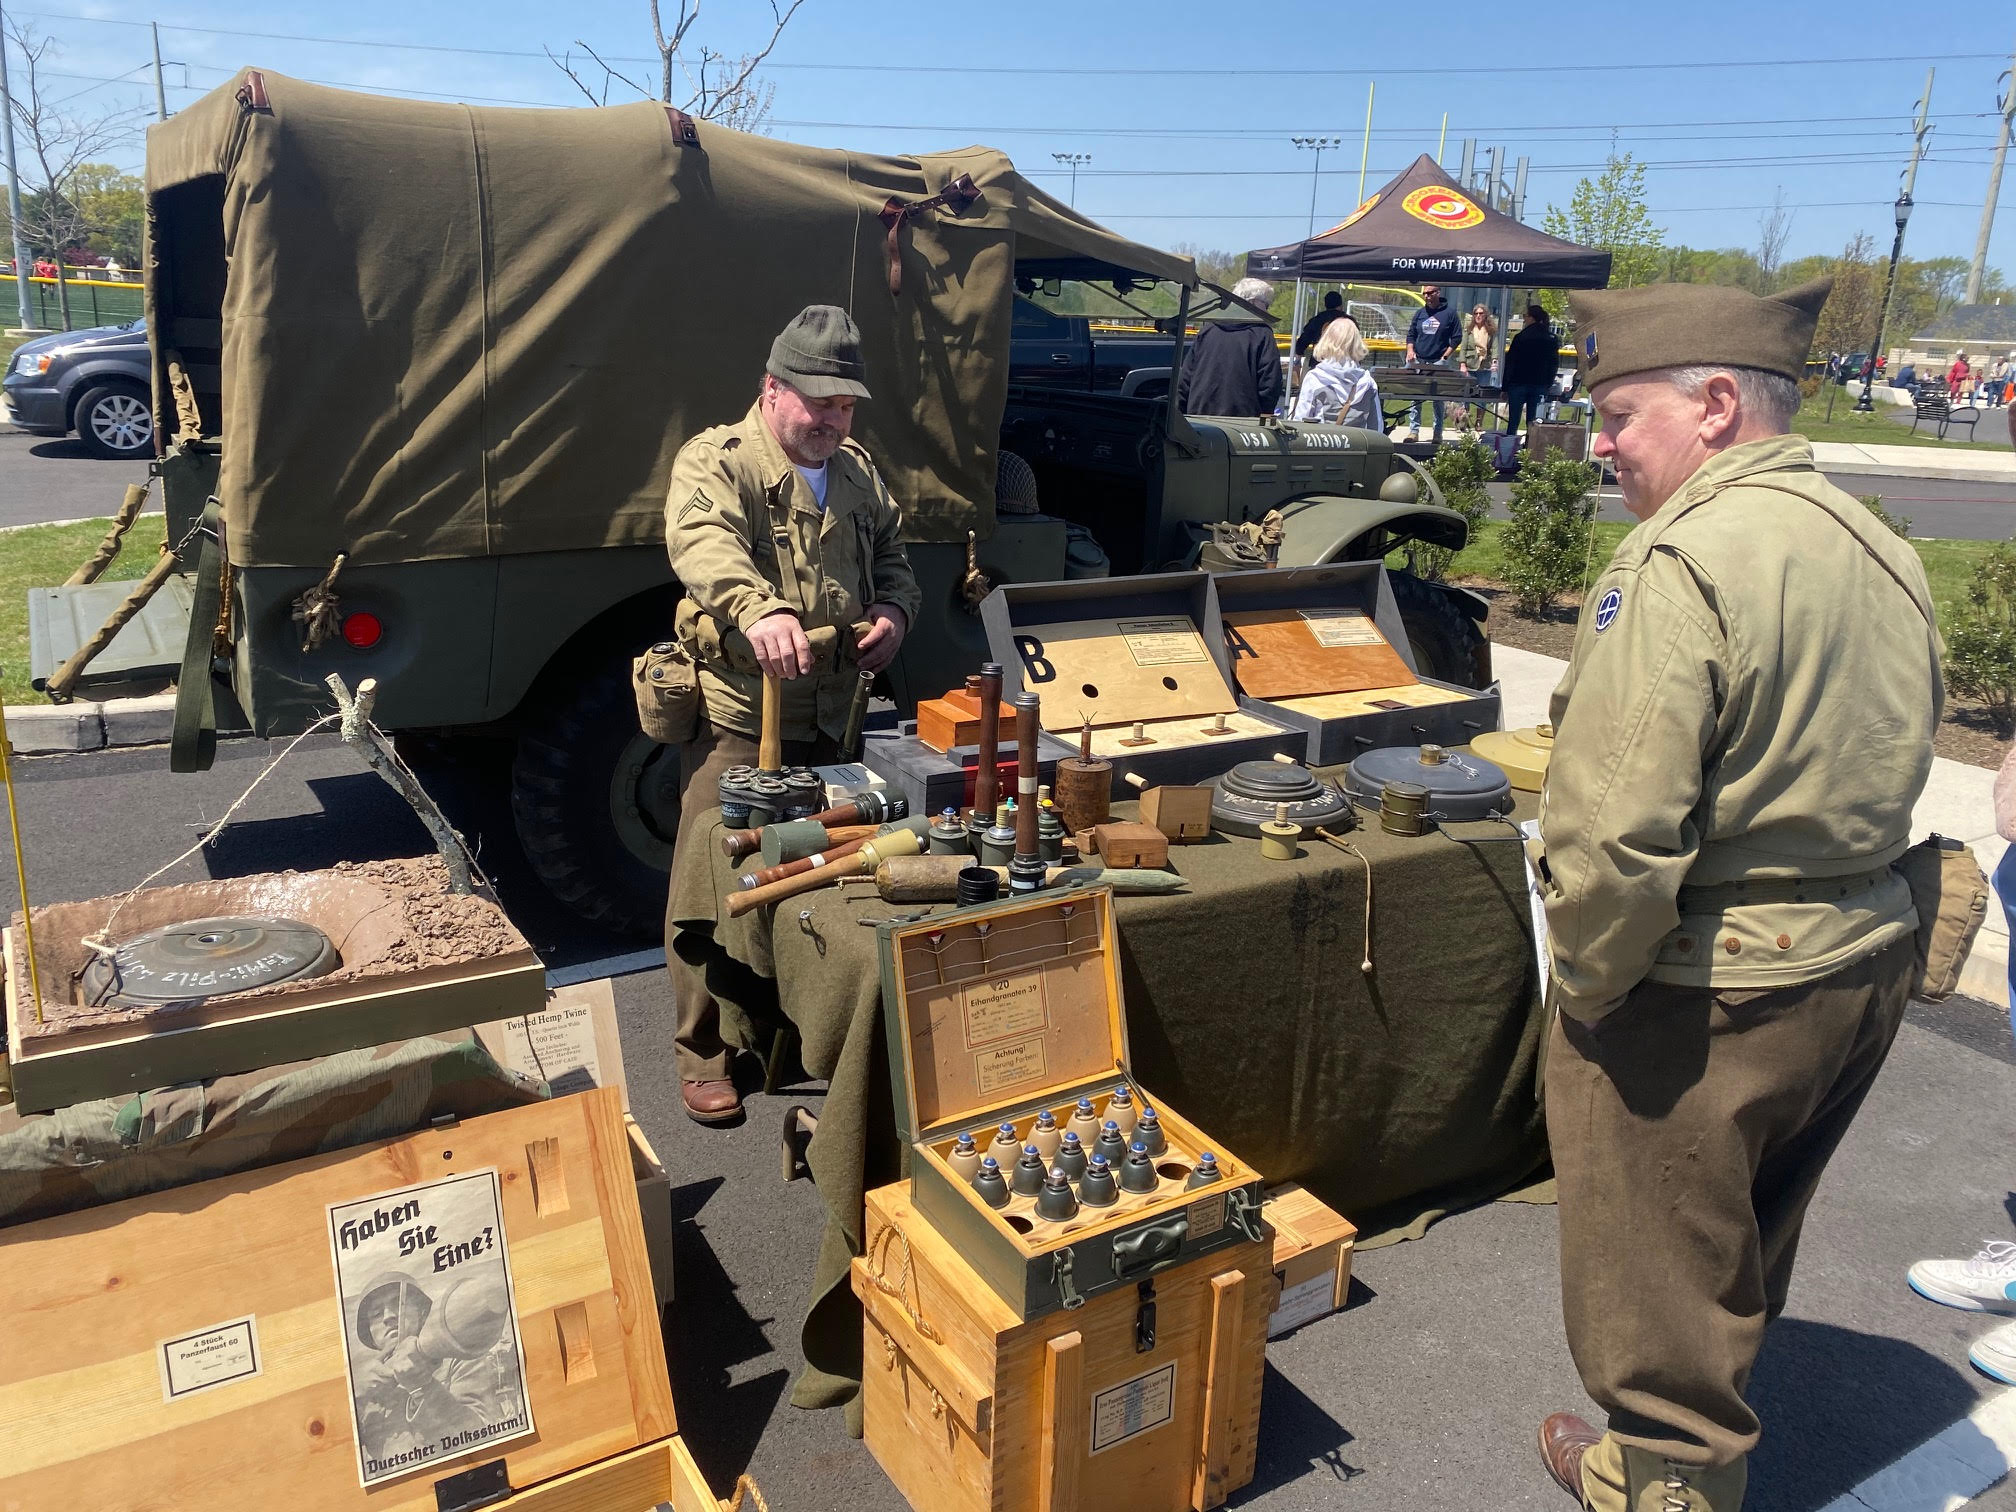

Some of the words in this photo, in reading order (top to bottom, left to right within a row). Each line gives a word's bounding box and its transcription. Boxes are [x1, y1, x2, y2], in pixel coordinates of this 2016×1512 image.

[1392, 258, 1416, 269] FOR
[1420, 259, 1455, 270] WHAT
[1456, 255, 1494, 274] ALES
[1496, 261, 1525, 273] YOU!
[1239, 432, 1270, 447] USA
[1223, 620, 1259, 660] A
[1013, 635, 1057, 683] B
[997, 979, 1010, 991] 20
[970, 989, 1027, 1007] Eihandgranaten
[1028, 984, 1037, 993] 39
[538, 1013, 562, 1025] Hemp
[563, 1008, 587, 1019] Twine
[535, 1036, 548, 1044] 500
[549, 1032, 564, 1042] Feet
[994, 1044, 1026, 1060] Achtung!
[983, 1059, 1014, 1073] Sicherung
[339, 1199, 421, 1252] Haben
[398, 1225, 439, 1257] Sie
[432, 1226, 493, 1274] Eine?
[180, 1343, 227, 1360] Panzerfaust
[228, 1338, 239, 1346] 60
[200, 1335, 224, 1347] Stück
[366, 1445, 436, 1476] Duetscher
[440, 1413, 524, 1449] Volkssturm!
